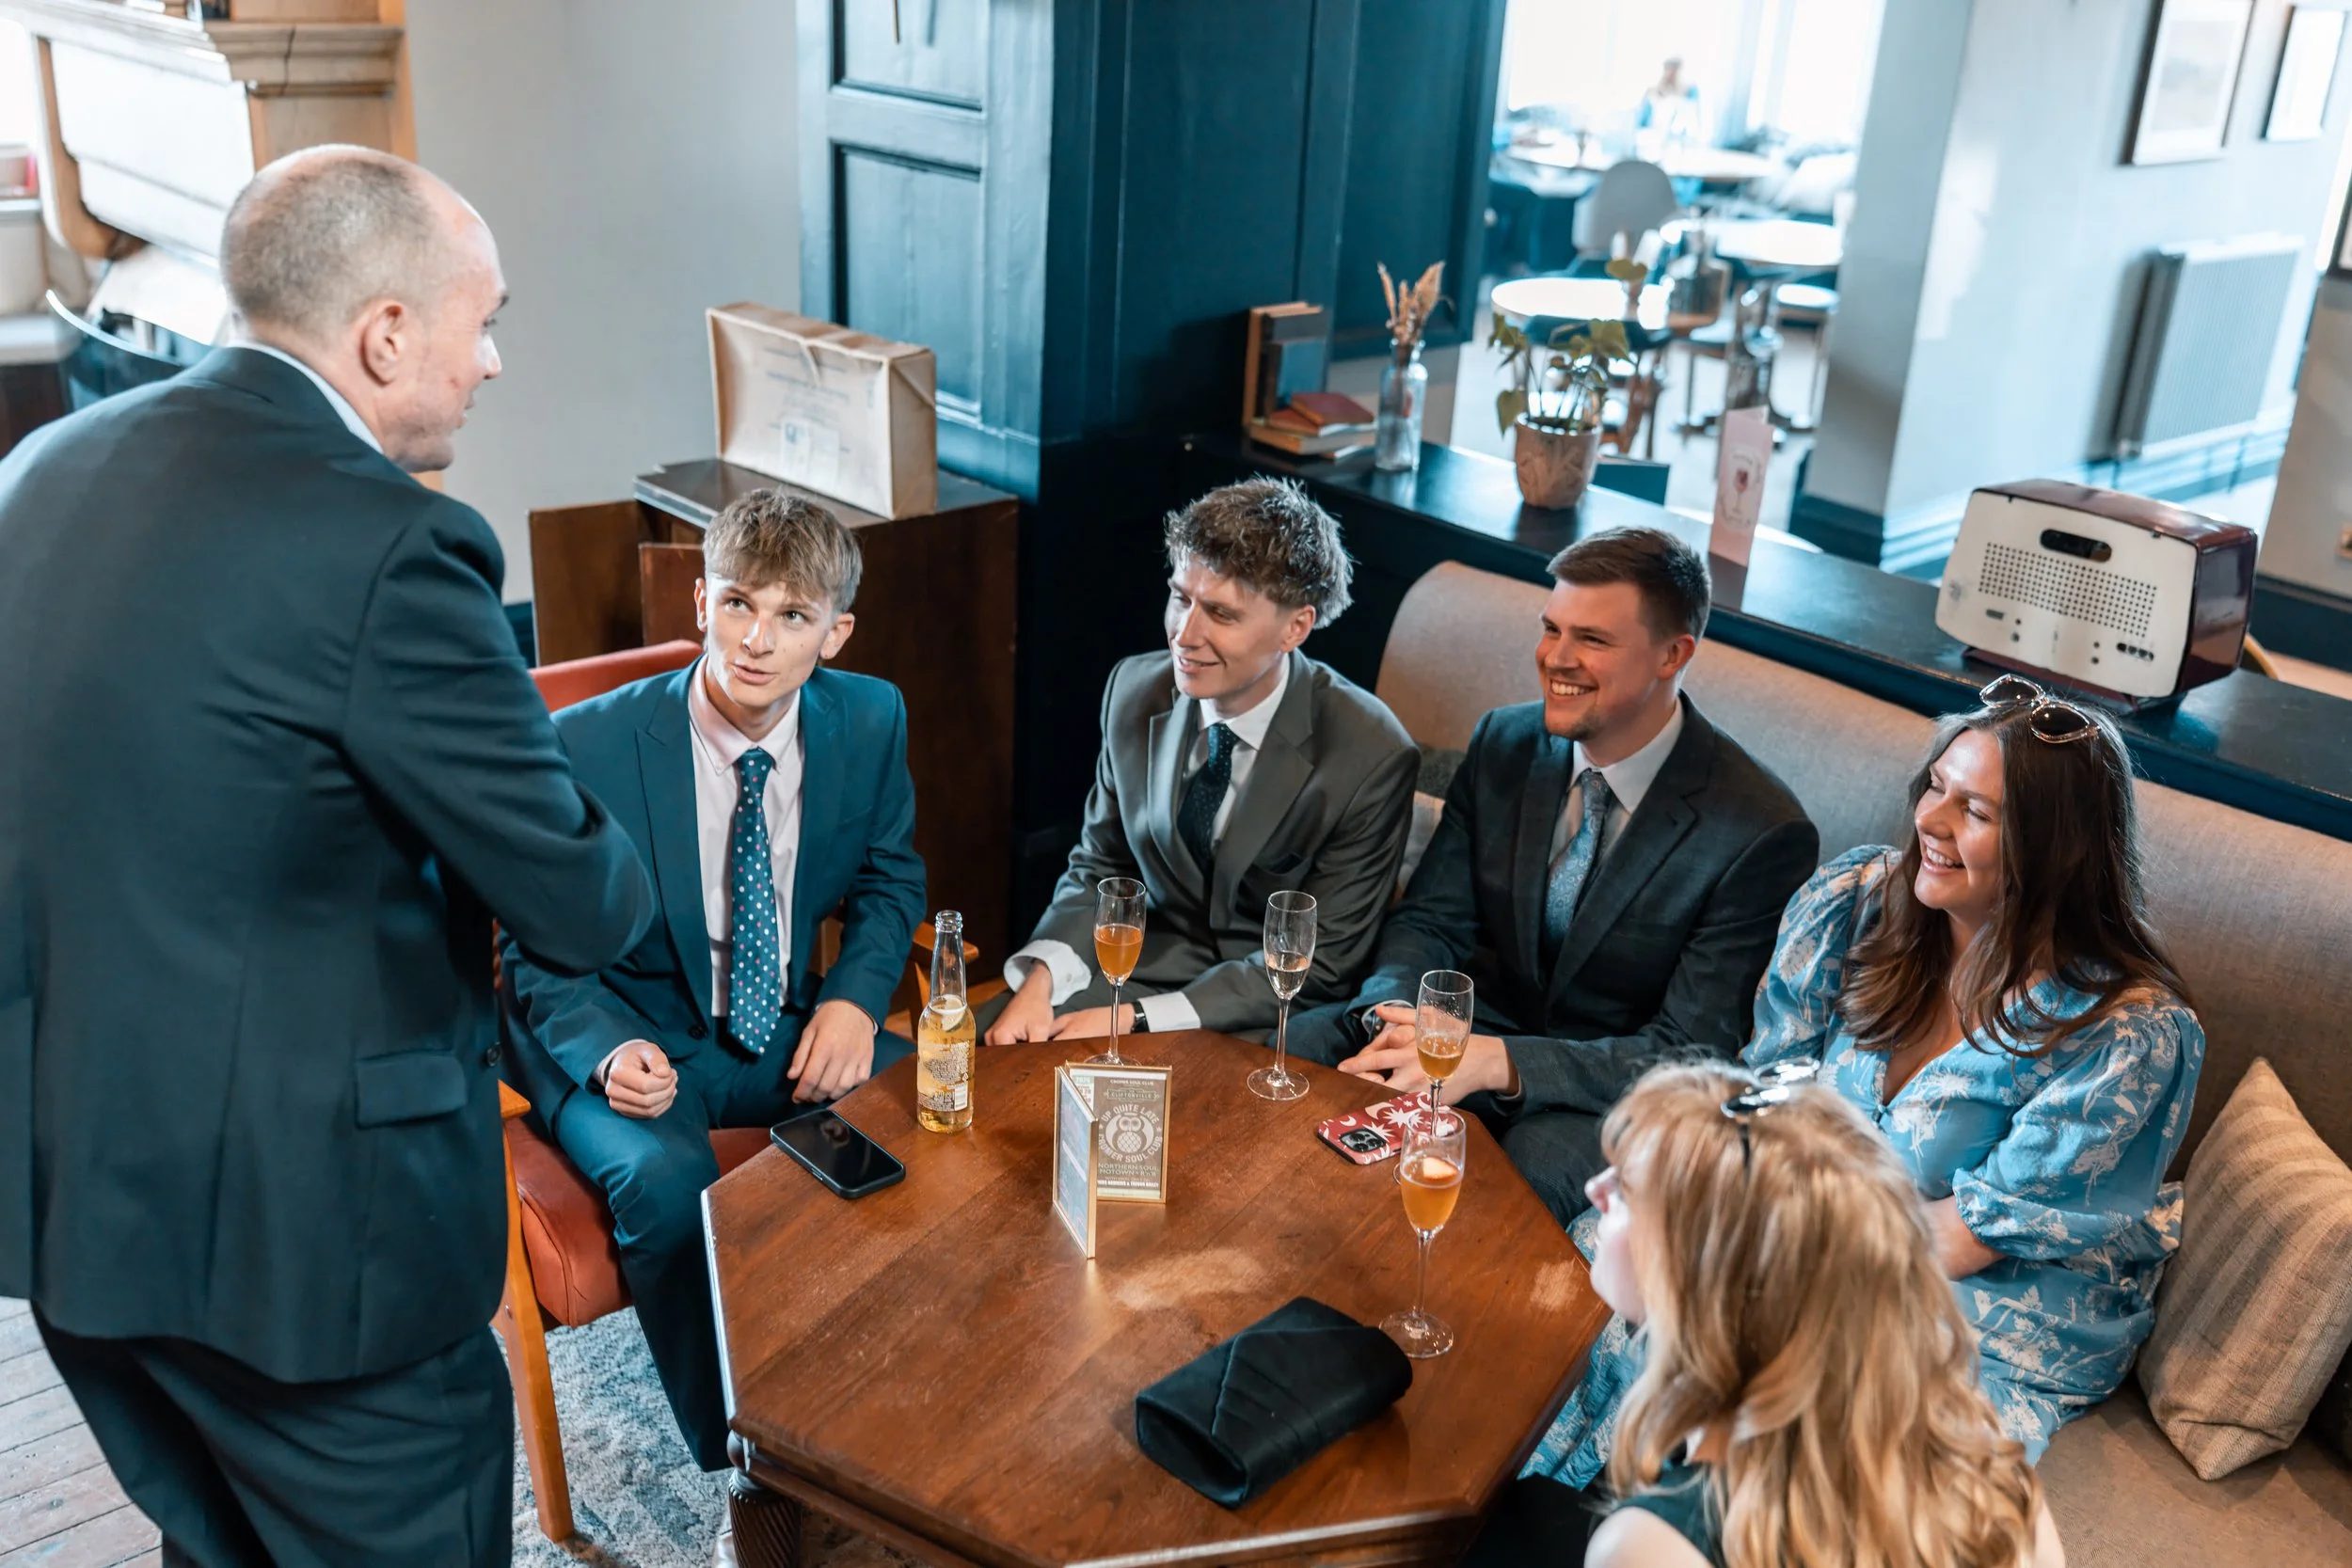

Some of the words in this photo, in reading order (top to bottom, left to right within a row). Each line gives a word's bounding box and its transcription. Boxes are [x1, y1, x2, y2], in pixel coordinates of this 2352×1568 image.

[1111, 1091, 1152, 1100] CLIFTONVILLE
[1101, 1110, 1112, 1122] UP
[1112, 1103, 1139, 1115] QUITE
[1139, 1106, 1160, 1125] LATE
[1098, 1133, 1123, 1162] CROMER
[1125, 1152, 1149, 1163] SOUL
[1147, 1135, 1163, 1156] CLUB
